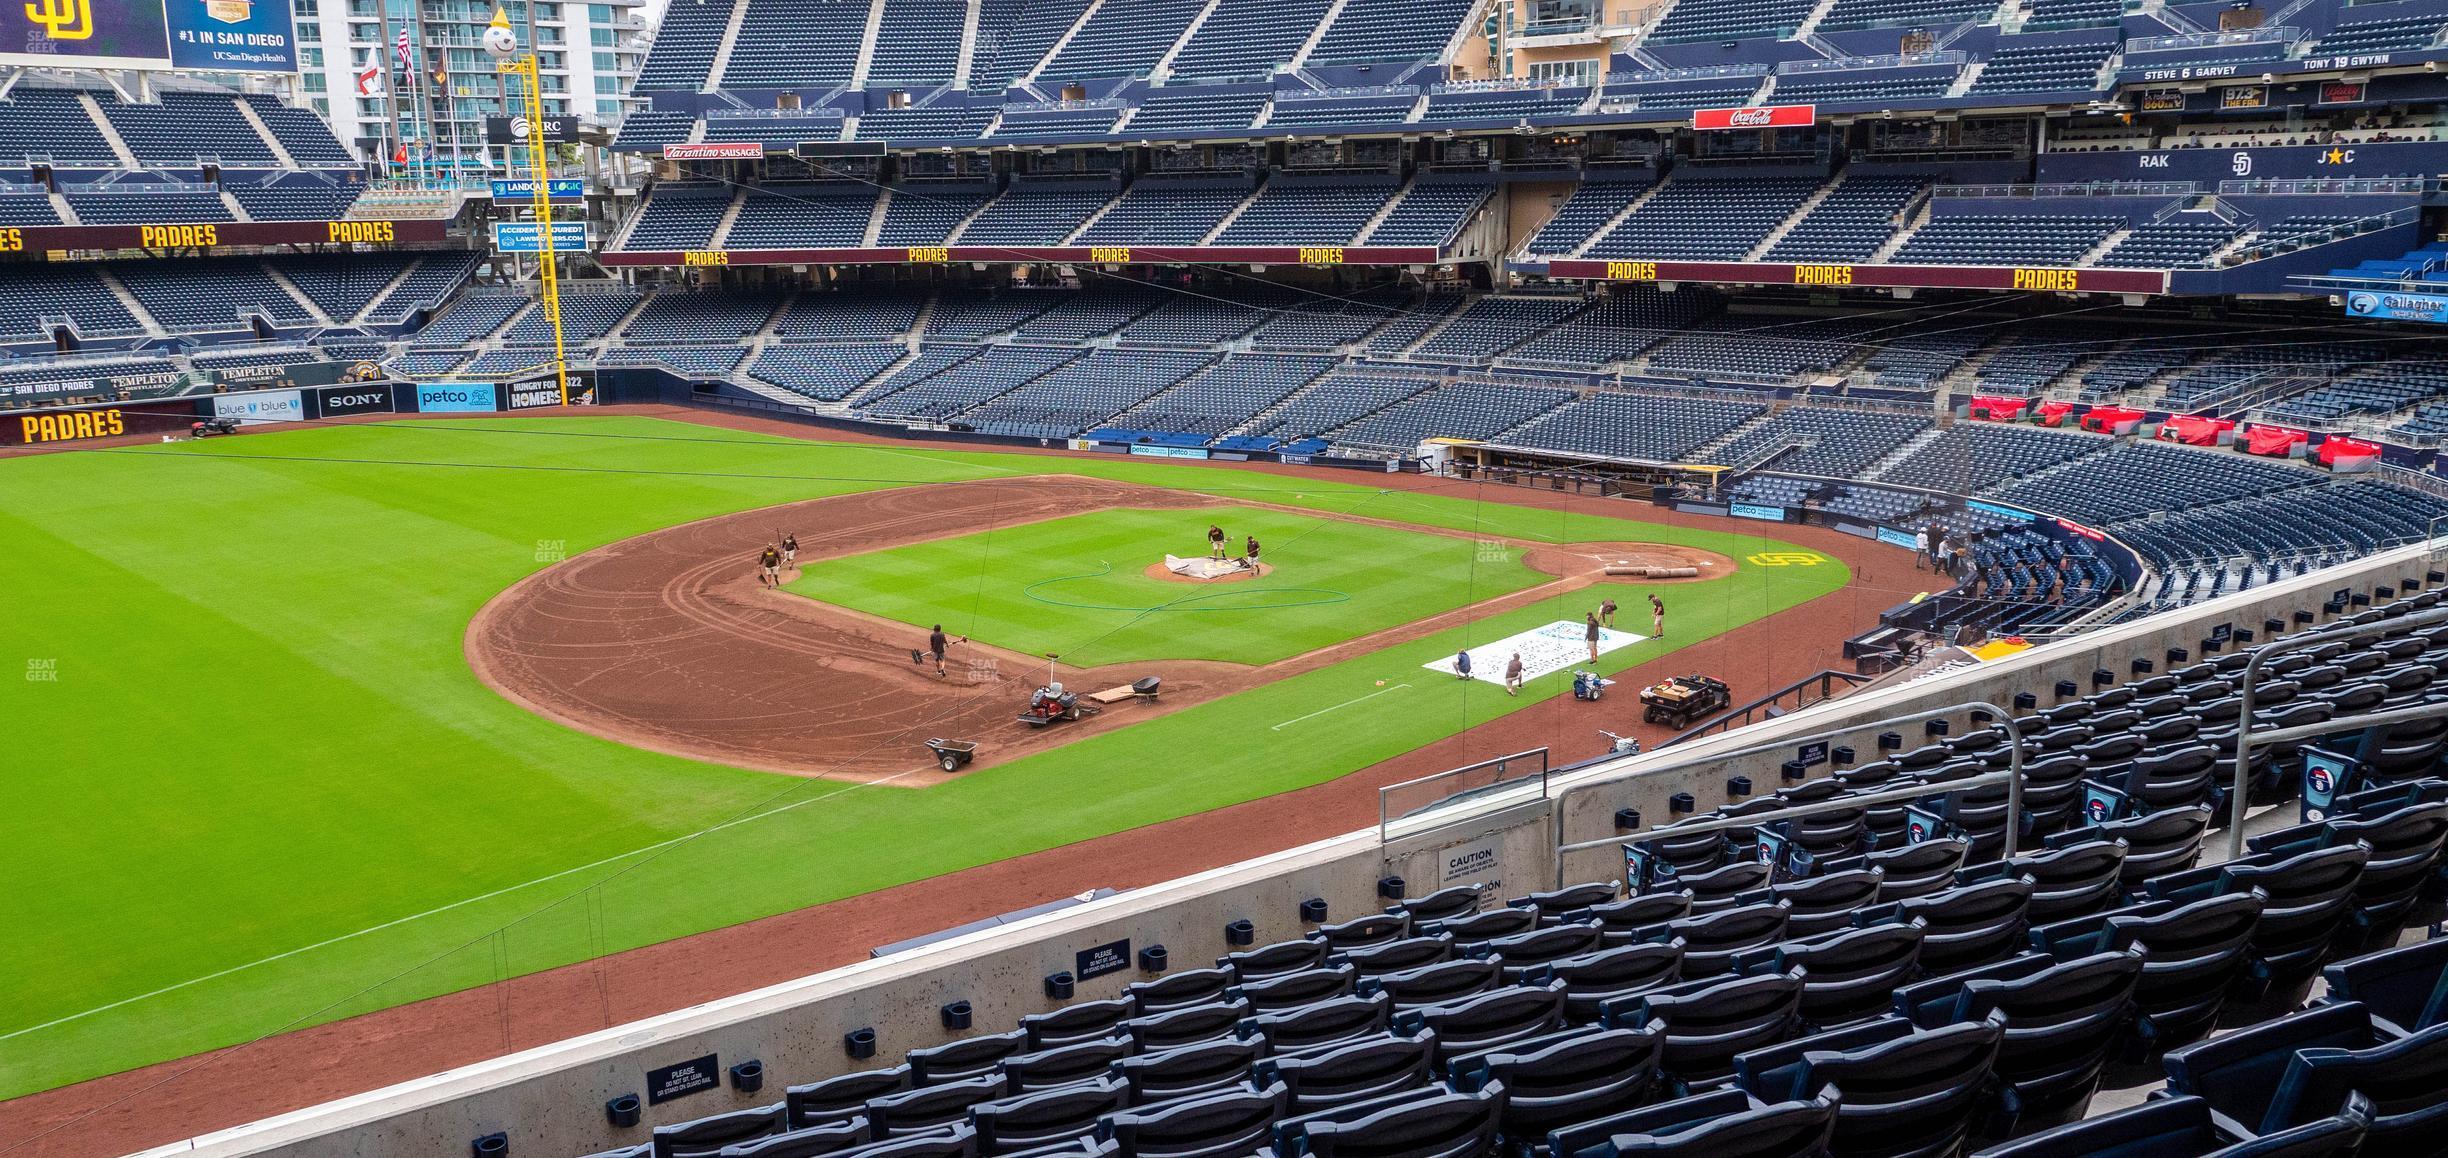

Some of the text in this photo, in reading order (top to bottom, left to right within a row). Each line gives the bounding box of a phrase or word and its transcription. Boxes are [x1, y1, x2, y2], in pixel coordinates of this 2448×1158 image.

[178, 31, 285, 47] #1 IN SAN DIEGO
[213, 51, 226, 60] UC
[2304, 55, 2389, 69] TONY 19 GWYNN
[2145, 66, 2236, 80] STEVE 6 GARVEY
[667, 146, 761, 158] Tarantino SAUSAGES
[2139, 155, 2169, 168] RAK
[141, 225, 217, 248] PADRES
[328, 221, 394, 242] PADRES
[686, 251, 728, 265] PADRES
[909, 248, 948, 262] PADRES
[1092, 248, 1130, 263] PADRES
[1300, 248, 1343, 264] PADRES
[1607, 262, 1656, 280] PADRES
[1795, 265, 1852, 285] PADRES
[2013, 268, 2077, 291] PADRES
[2383, 296, 2445, 312] Gallagher
[221, 366, 286, 380] TEMPLETON
[15, 386, 33, 395] SAN
[35, 384, 60, 393] DIEGO
[62, 381, 95, 391] PADRES
[111, 374, 179, 388] TEMPLETON
[514, 381, 556, 392] HUNGRY FOR
[566, 376, 582, 387] 322
[329, 393, 384, 408] SONY
[422, 390, 468, 406] petco
[511, 389, 562, 407] HOMERS
[218, 404, 246, 415] blue
[261, 400, 288, 411] blue
[21, 409, 124, 444] PADRES
[1732, 505, 1757, 515] petco
[1449, 848, 1492, 868] CAUTION
[1094, 948, 1113, 959] PLEASE
[665, 1080, 673, 1088] DO
[673, 1078, 682, 1086] NOT
[690, 1072, 702, 1081] LEAN
[671, 1066, 695, 1080] PLEASE
[664, 1086, 679, 1095] STAND
[686, 1080, 702, 1089] GUARD
[701, 1076, 712, 1084] RAIL
